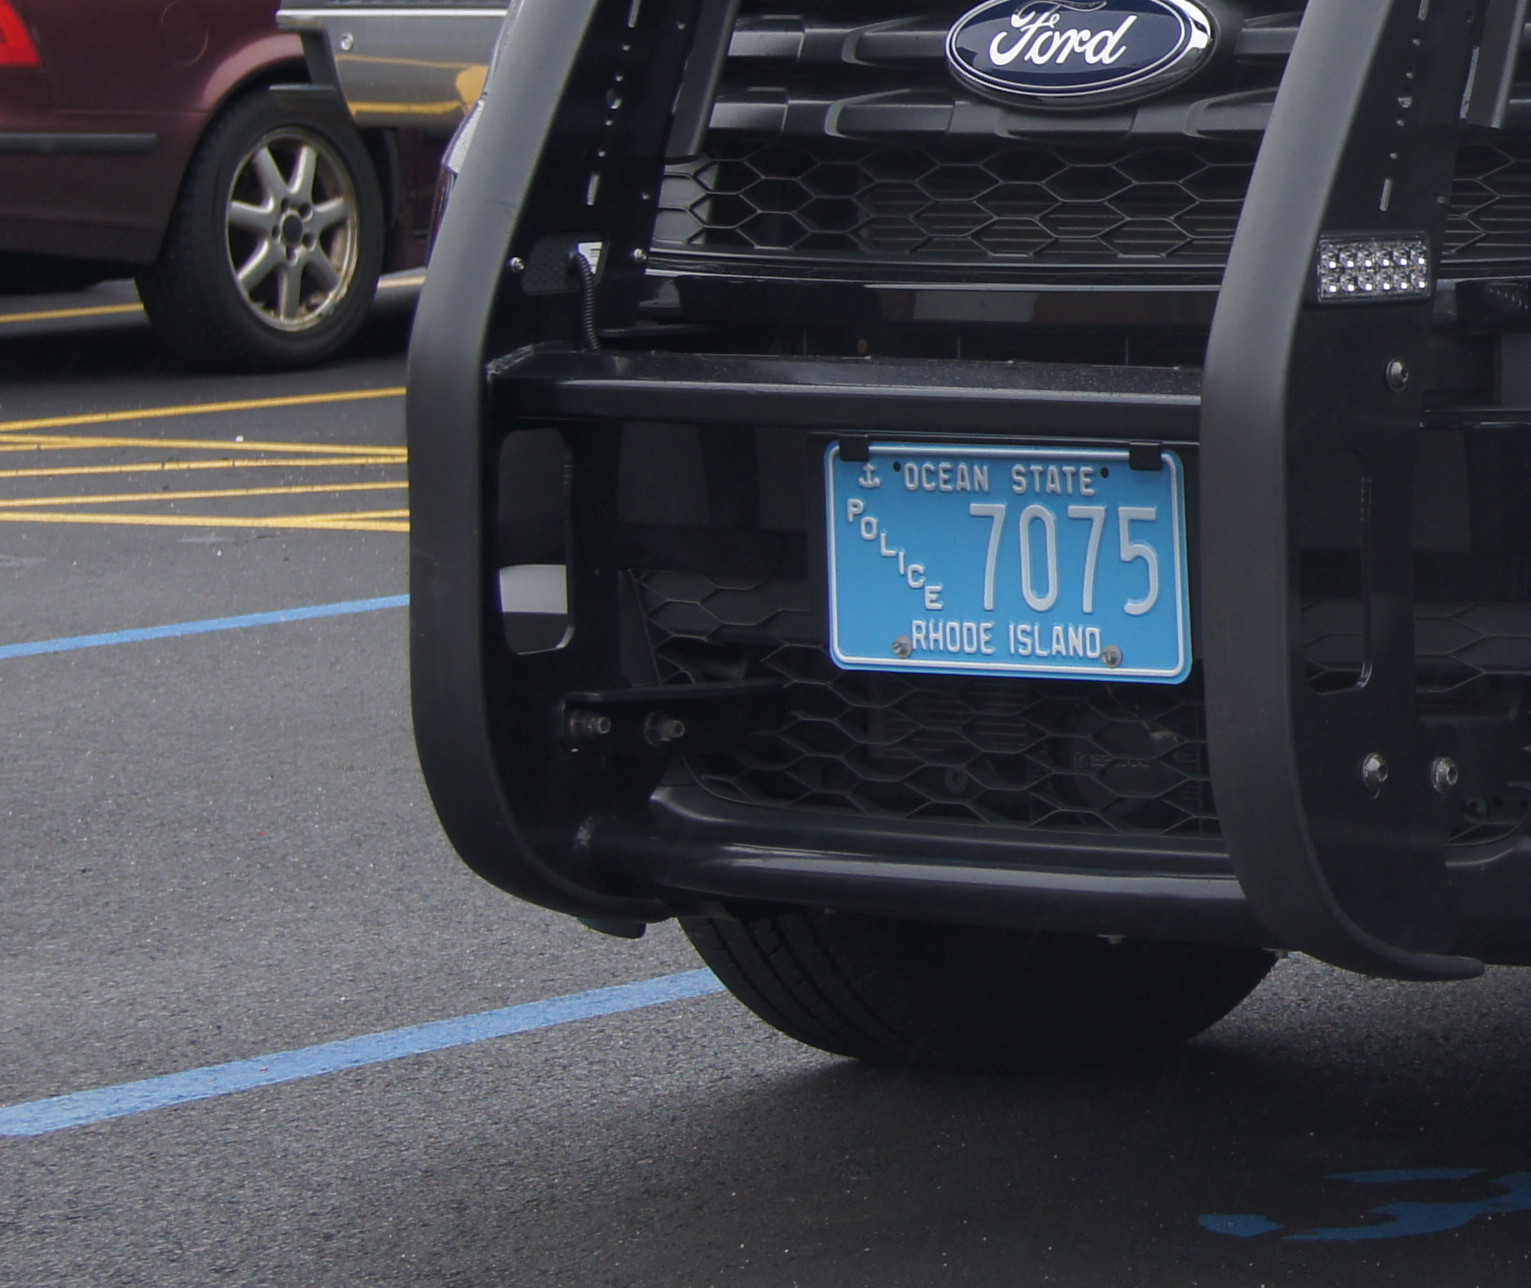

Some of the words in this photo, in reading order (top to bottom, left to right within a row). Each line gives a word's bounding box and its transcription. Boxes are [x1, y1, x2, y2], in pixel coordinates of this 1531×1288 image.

[904, 461, 989, 493] OCEAN
[1011, 464, 1096, 496] STATE
[847, 498, 944, 611] POLICE
[969, 502, 1159, 616] 7075
[911, 619, 995, 655] RHODE
[1008, 622, 1101, 660] ISLAND
